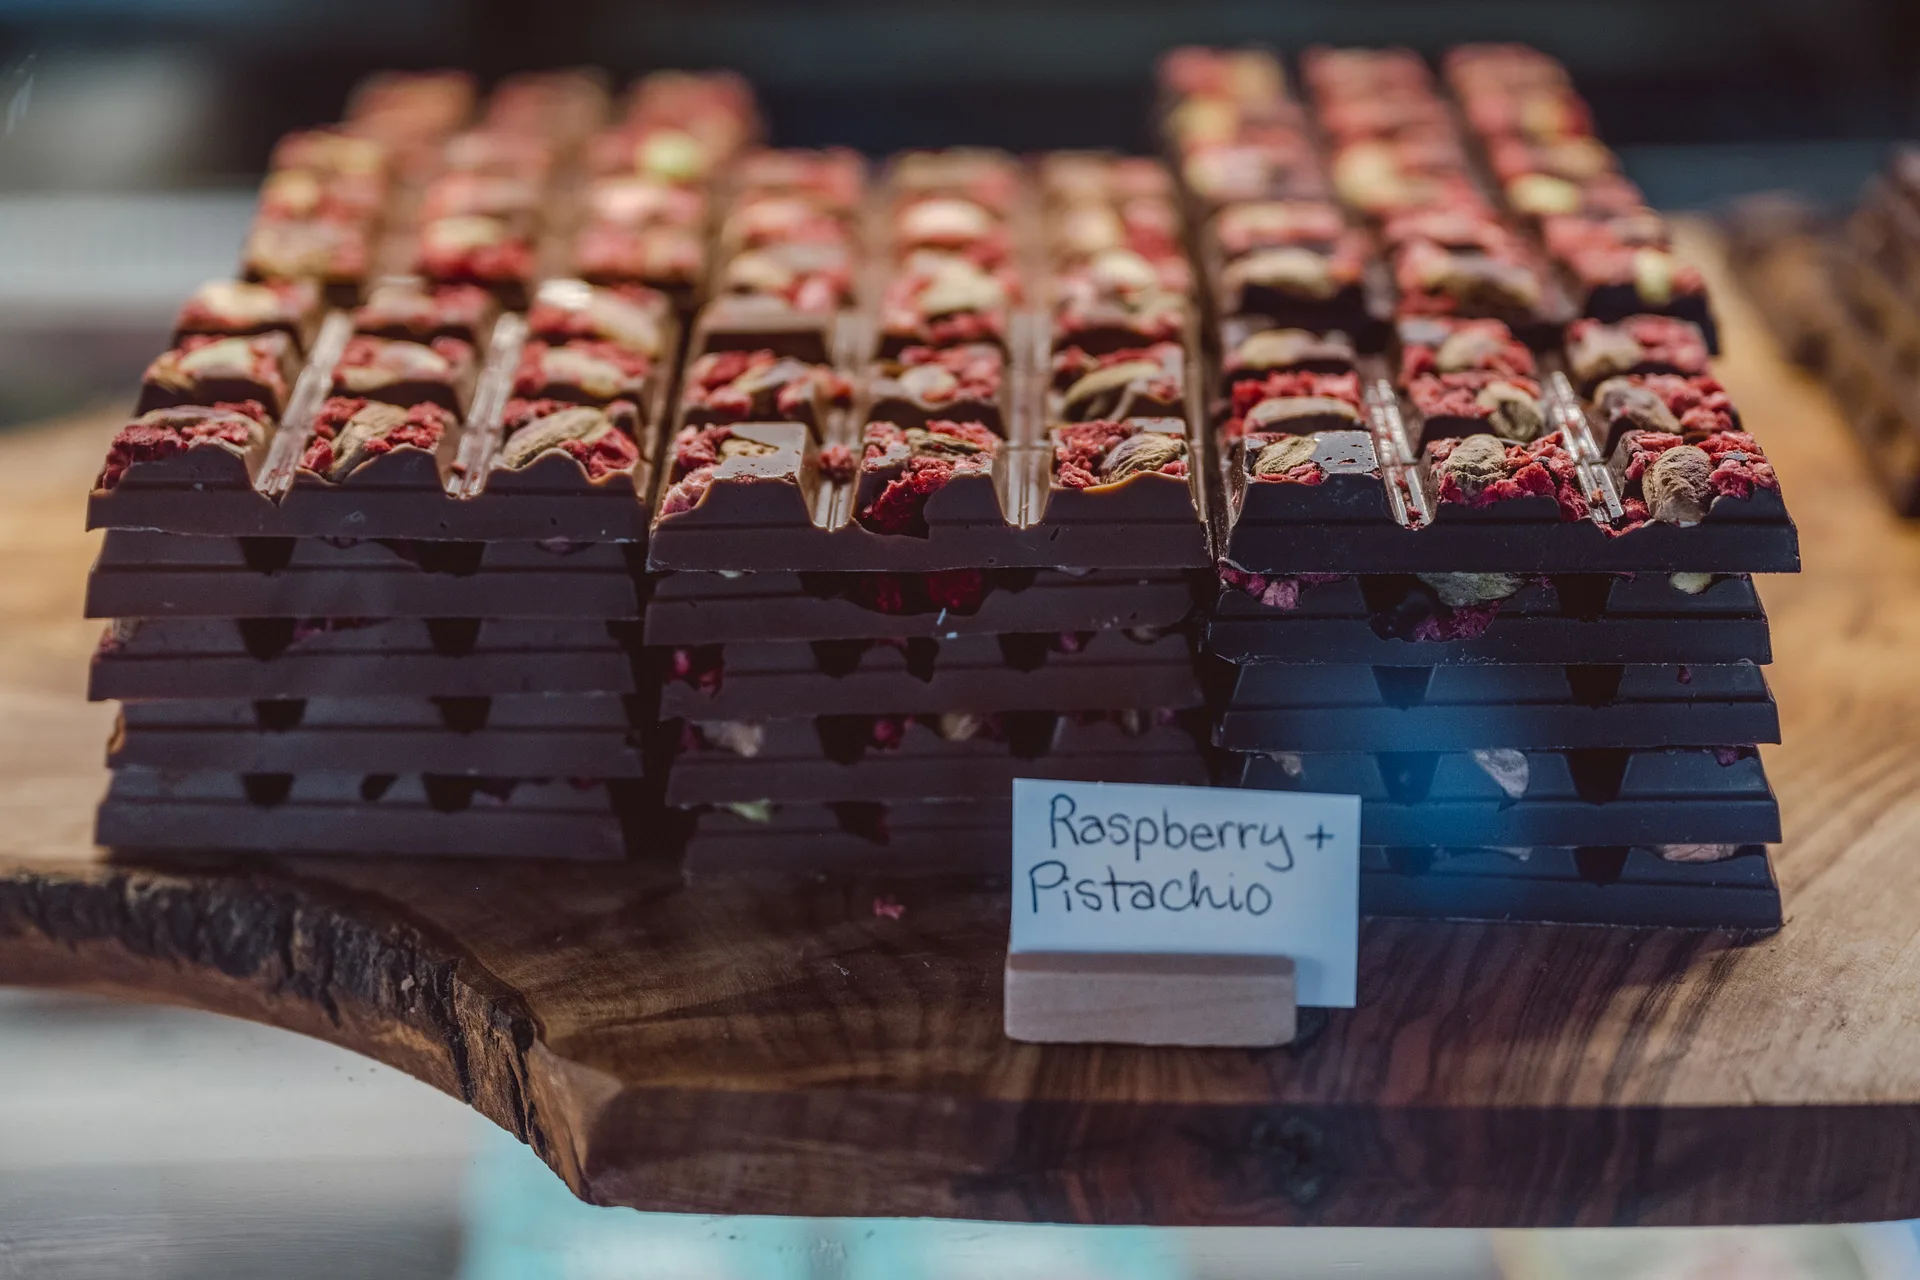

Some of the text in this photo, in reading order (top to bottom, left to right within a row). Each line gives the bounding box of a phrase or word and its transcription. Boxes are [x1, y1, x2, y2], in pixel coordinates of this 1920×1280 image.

[1049, 793, 1335, 872] Raspberry +
[1028, 859, 1273, 916] Pistachio
